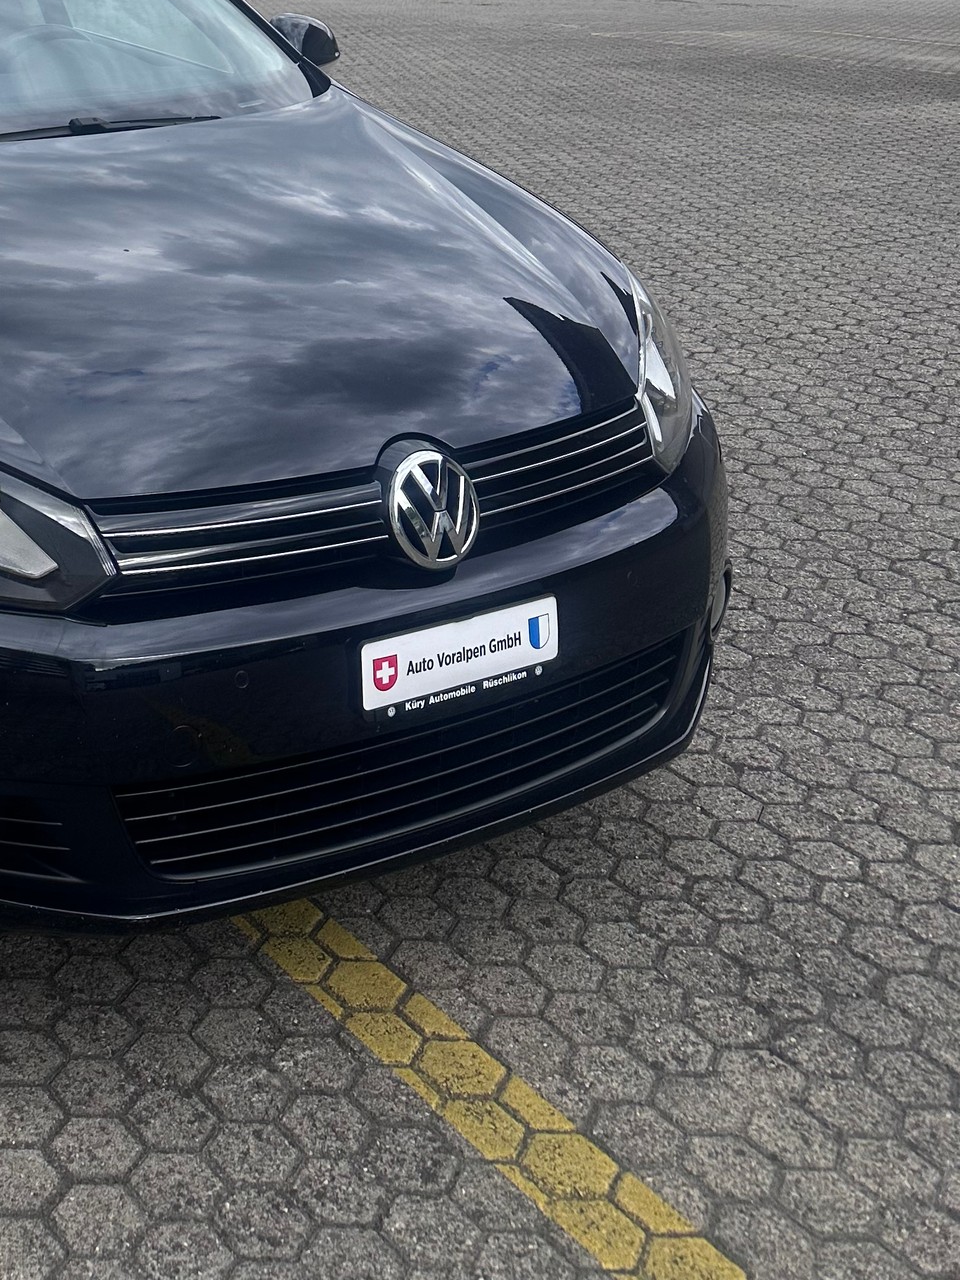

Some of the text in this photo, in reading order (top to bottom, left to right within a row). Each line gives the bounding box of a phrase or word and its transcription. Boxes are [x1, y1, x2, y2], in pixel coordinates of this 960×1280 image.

[406, 631, 522, 676] Auto Voralpen GmbH
[405, 670, 527, 711] Küry Automobile Rüschlikon
